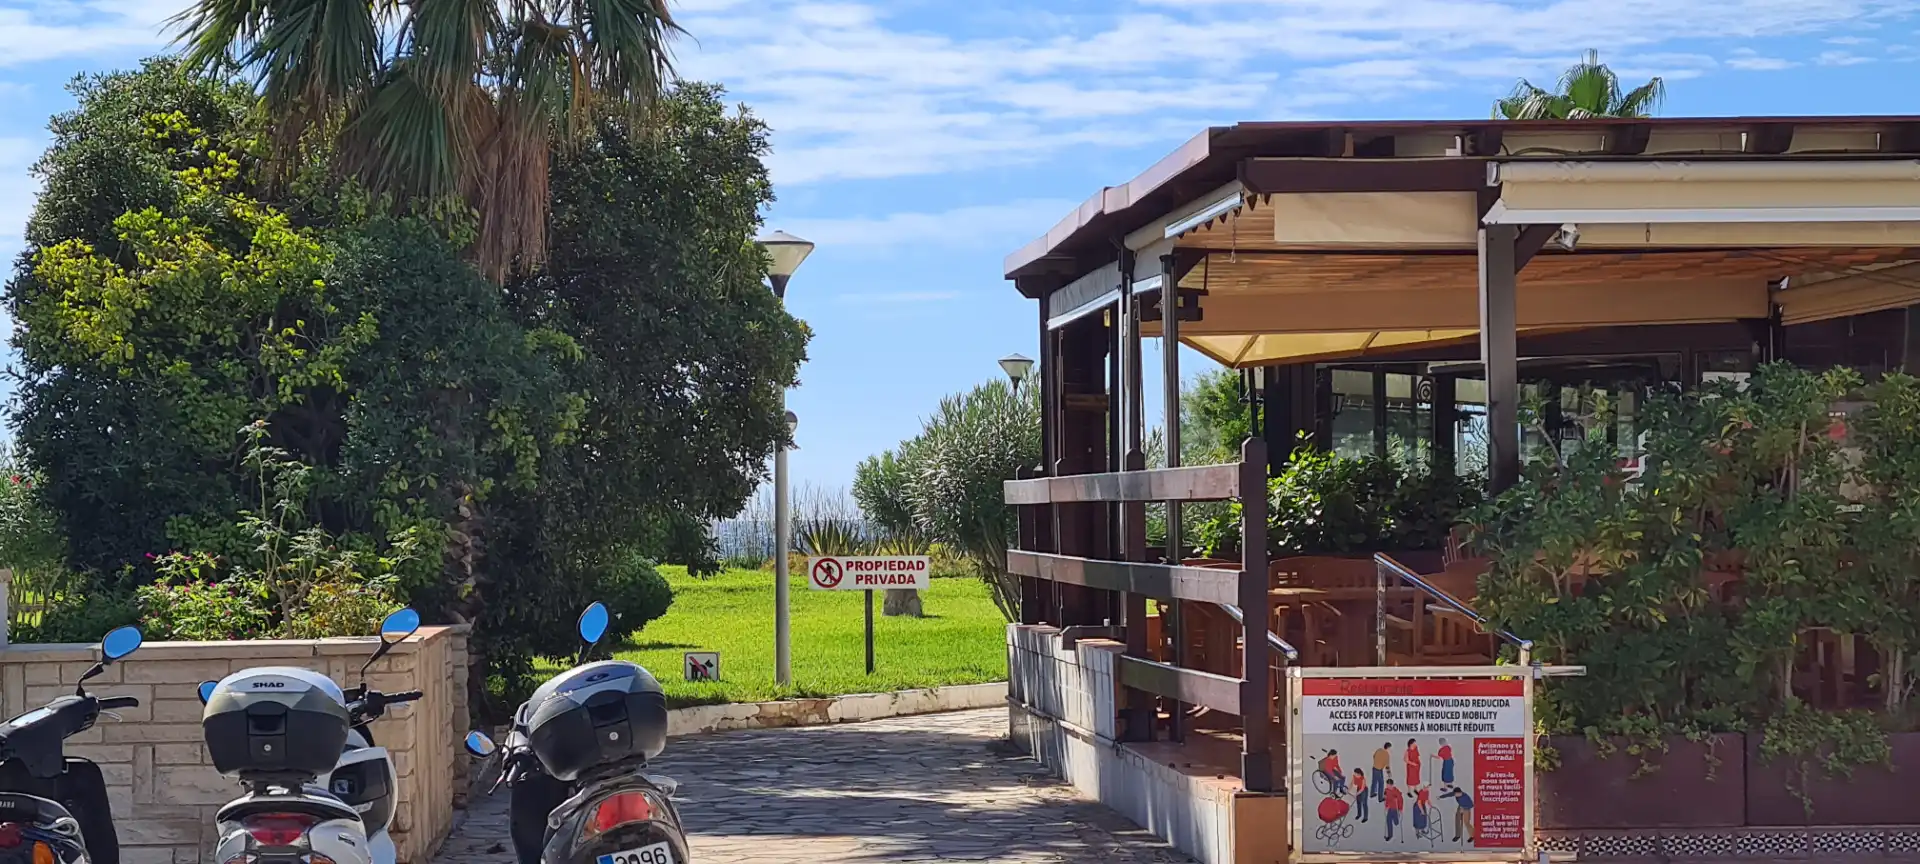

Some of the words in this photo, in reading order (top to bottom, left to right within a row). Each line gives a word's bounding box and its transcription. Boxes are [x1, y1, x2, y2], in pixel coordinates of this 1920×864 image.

[845, 560, 926, 571] PROPIEDAD
[855, 574, 916, 585] PRIVADA
[1317, 698, 1346, 708] ACCESO
[1347, 698, 1368, 708] PARA
[1369, 698, 1409, 708] PERSONAS
[1410, 698, 1426, 708] CON
[1427, 698, 1471, 708] MOVILIDAD
[1472, 698, 1510, 708] REDUCIDA
[1329, 710, 1357, 719] ACCESS
[1359, 710, 1374, 719] FOR
[1375, 710, 1403, 719] PEOPLE
[1405, 710, 1424, 719] WITH
[1425, 710, 1460, 719] REDUCED
[1462, 710, 1498, 719] MOBILITY
[1332, 721, 1355, 732] ACCÈS
[1357, 723, 1373, 732] AUX
[1374, 723, 1418, 732] PERSONNES
[1420, 721, 1425, 732] À
[1427, 721, 1462, 732] MOBILITÉ
[1463, 721, 1495, 732] RÉDUITE
